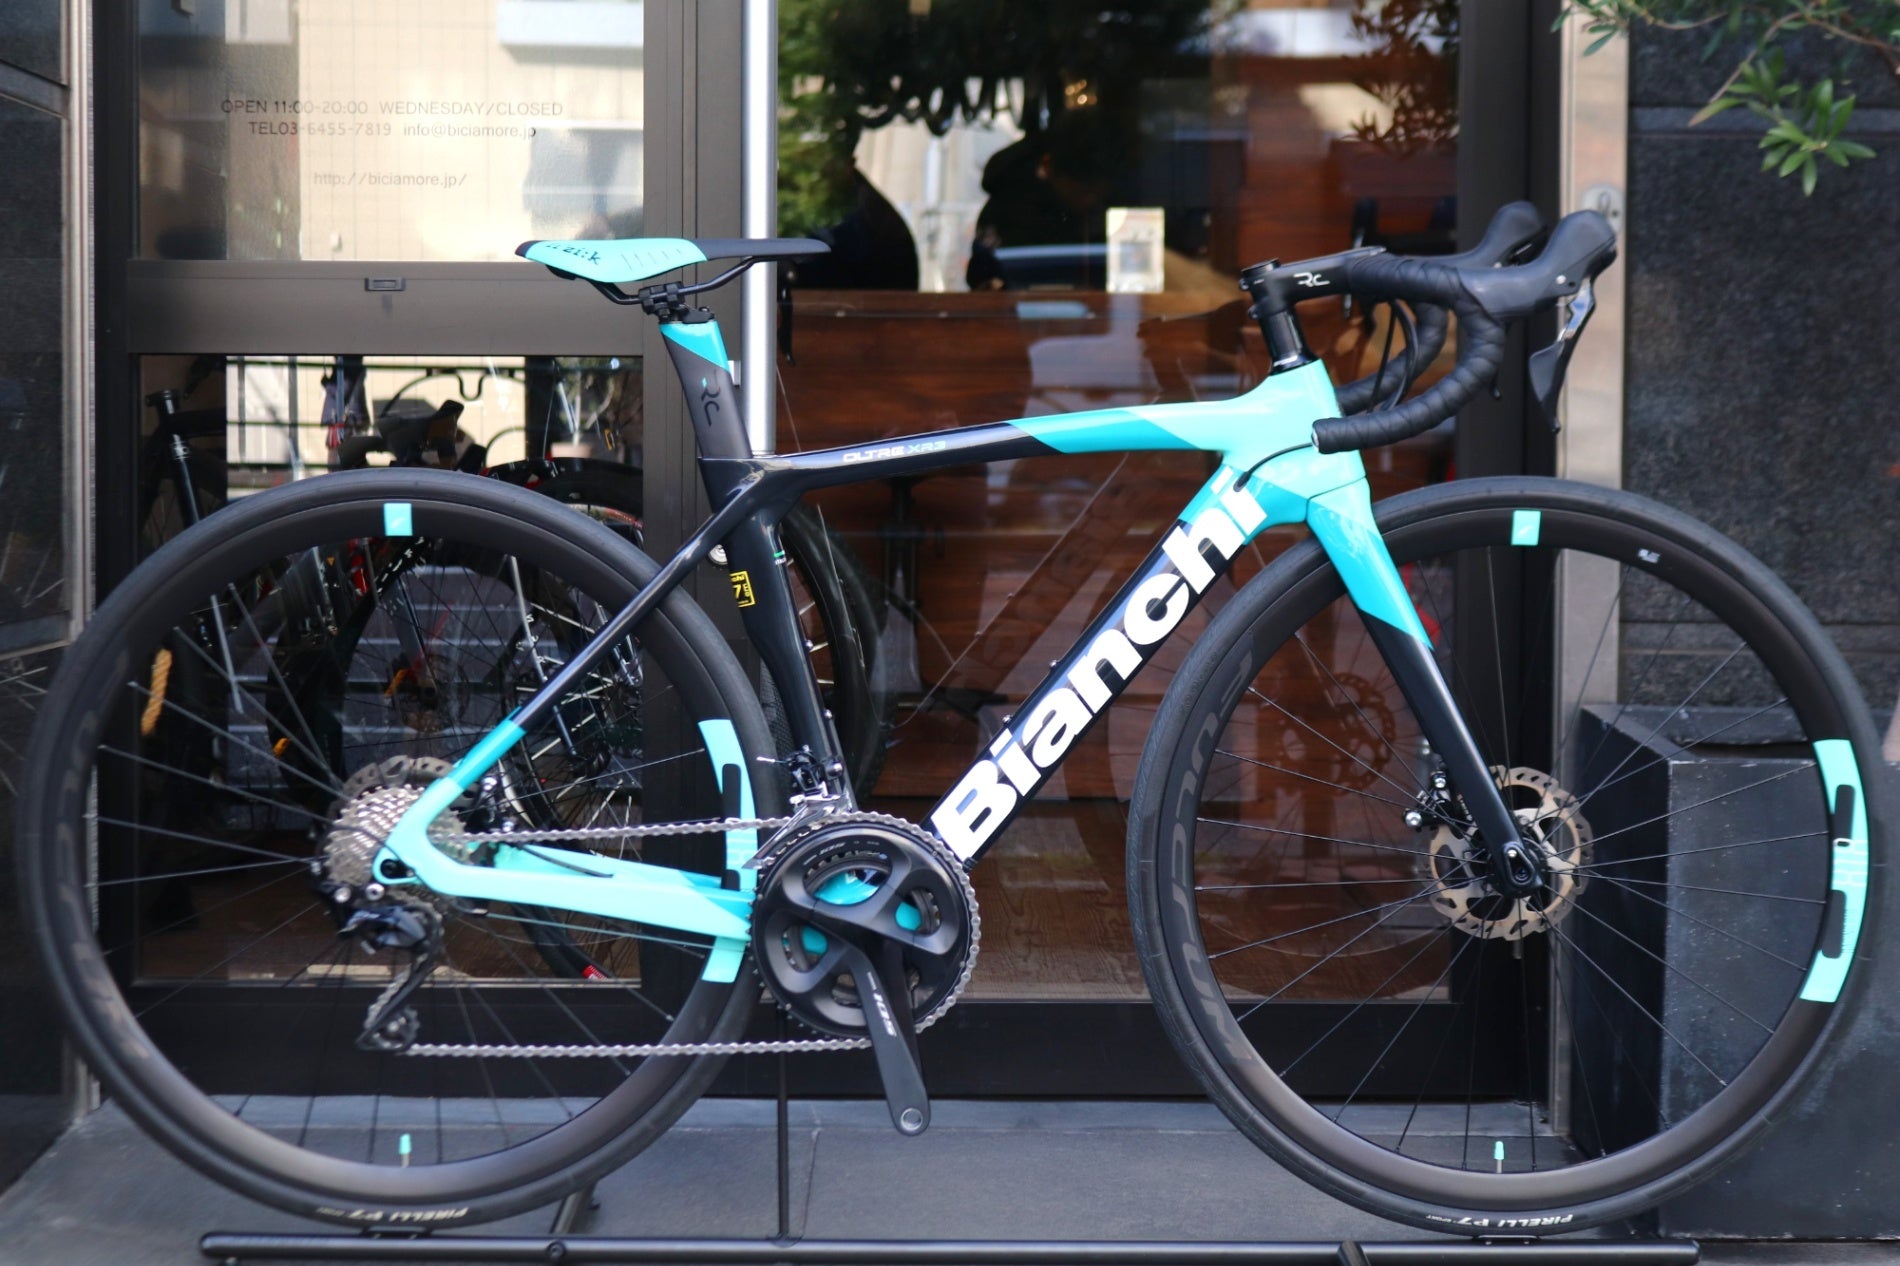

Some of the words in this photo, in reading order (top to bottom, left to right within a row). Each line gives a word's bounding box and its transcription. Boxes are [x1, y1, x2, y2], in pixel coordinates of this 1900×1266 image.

[220, 99, 268, 114] OPEN
[274, 100, 369, 115] 11:00-20:00
[379, 100, 564, 117] WEDNESDAY/CLOSED
[248, 121, 392, 137] TEL03-6455-7819
[403, 122, 537, 140] info@biciamore.jp
[314, 172, 468, 189] http://biciamore.jp/
[842, 446, 905, 463] OLTRE
[930, 465, 1268, 861] Bianchi
[1497, 1214, 1574, 1228] PIRELLI
